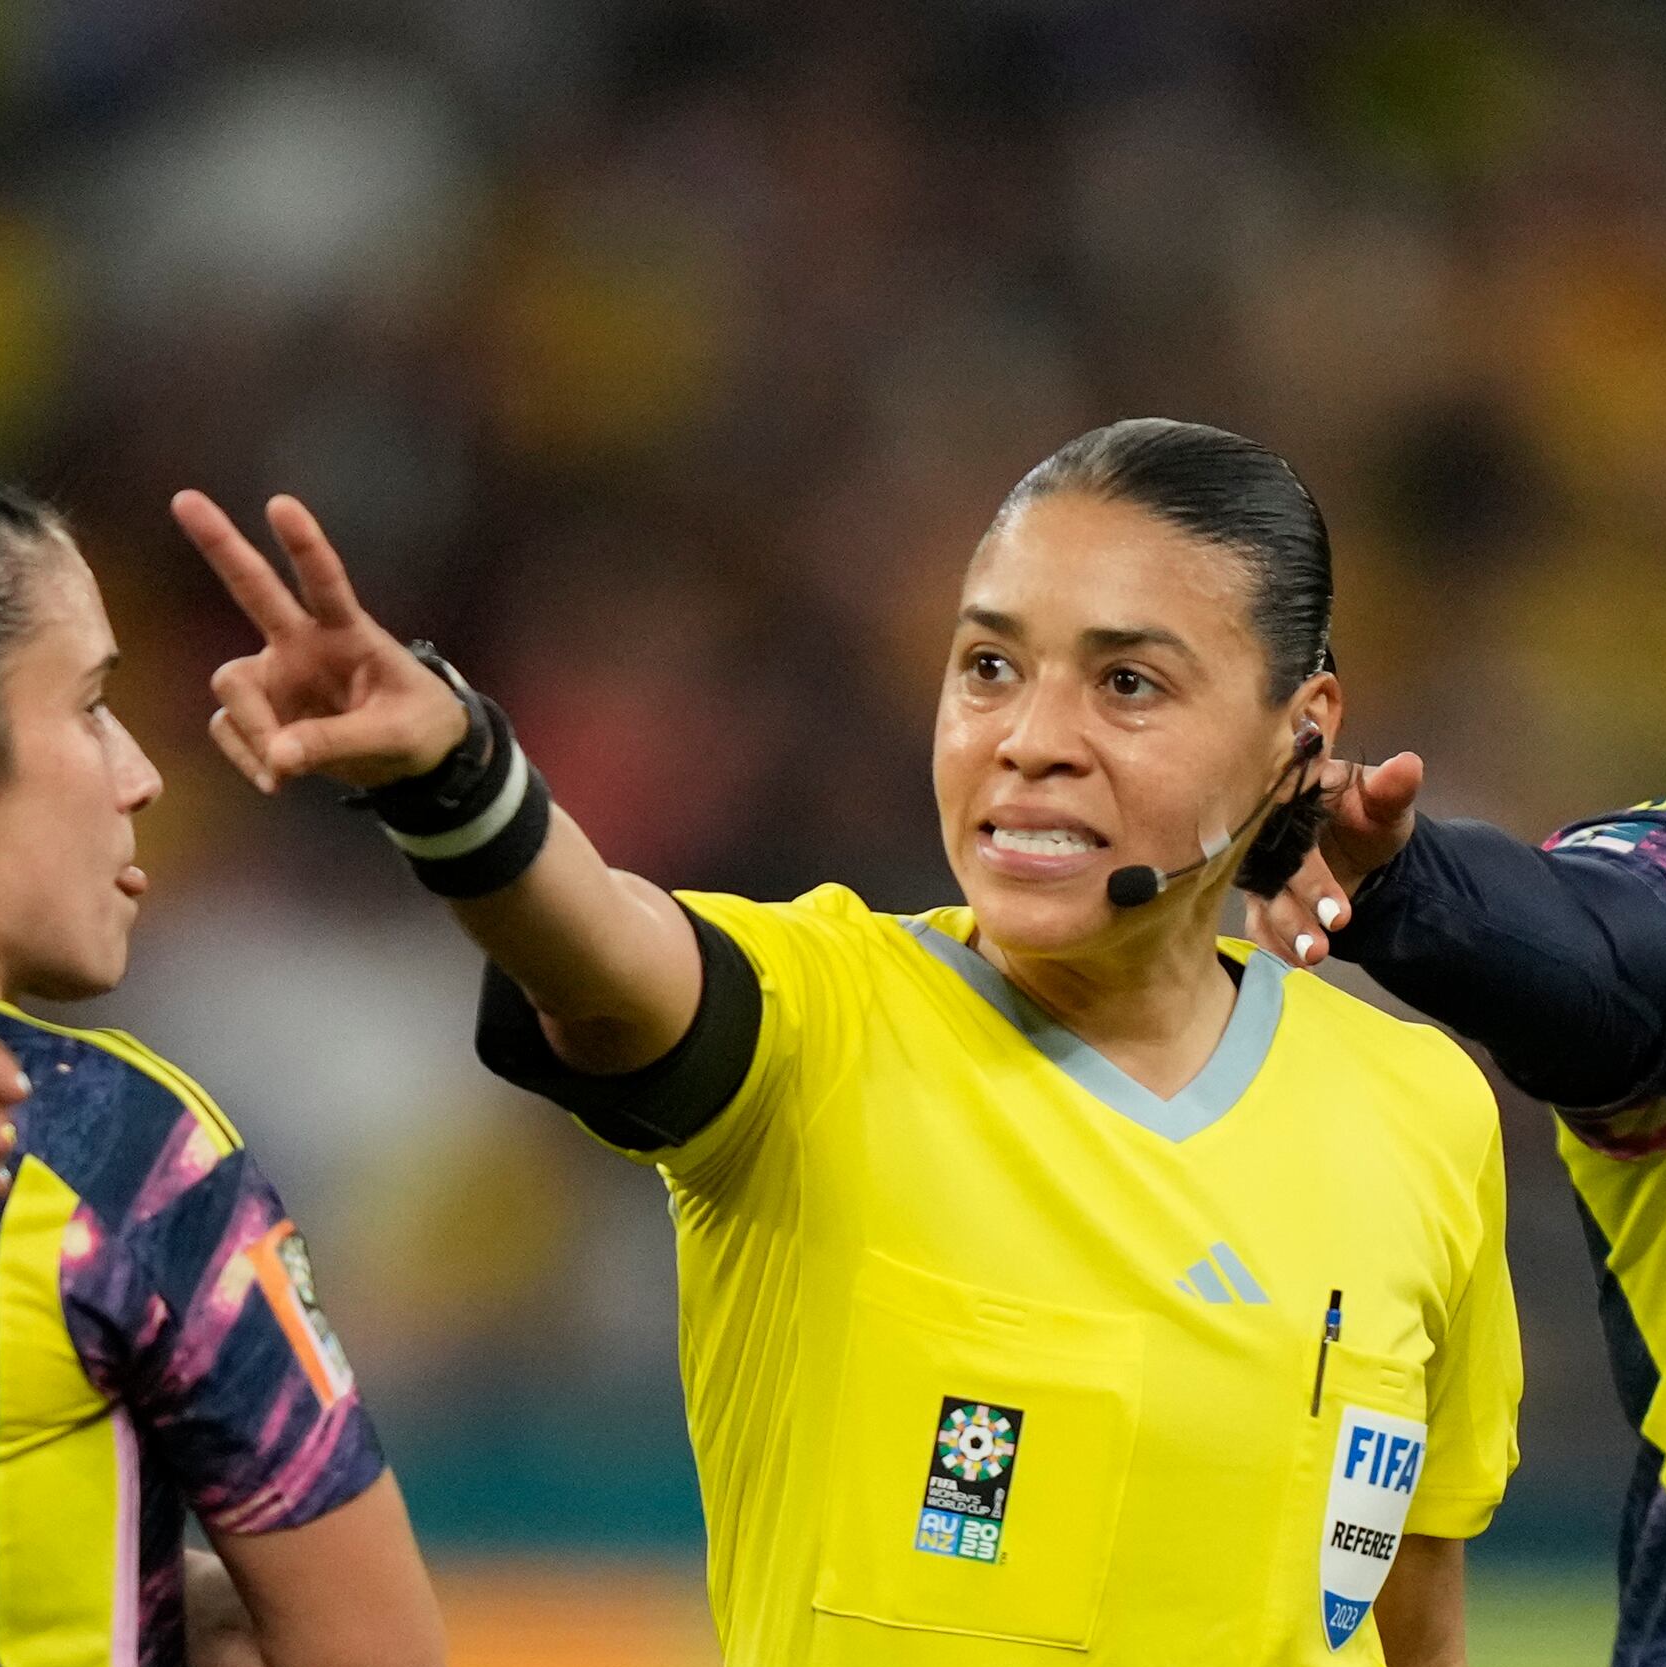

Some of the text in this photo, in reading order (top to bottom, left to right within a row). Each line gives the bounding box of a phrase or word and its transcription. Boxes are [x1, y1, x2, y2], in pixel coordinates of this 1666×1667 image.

[1344, 1425, 1420, 1494] FIFA
[929, 1475, 958, 1491] FIFA
[927, 1497, 991, 1515] WORLD CUP
[921, 1513, 959, 1535] AU
[963, 1519, 999, 1543] 20
[919, 1531, 955, 1553] NZ
[959, 1538, 996, 1560] 23
[1330, 1520, 1397, 1561] REFEREE
[1329, 1602, 1359, 1631] 2023
